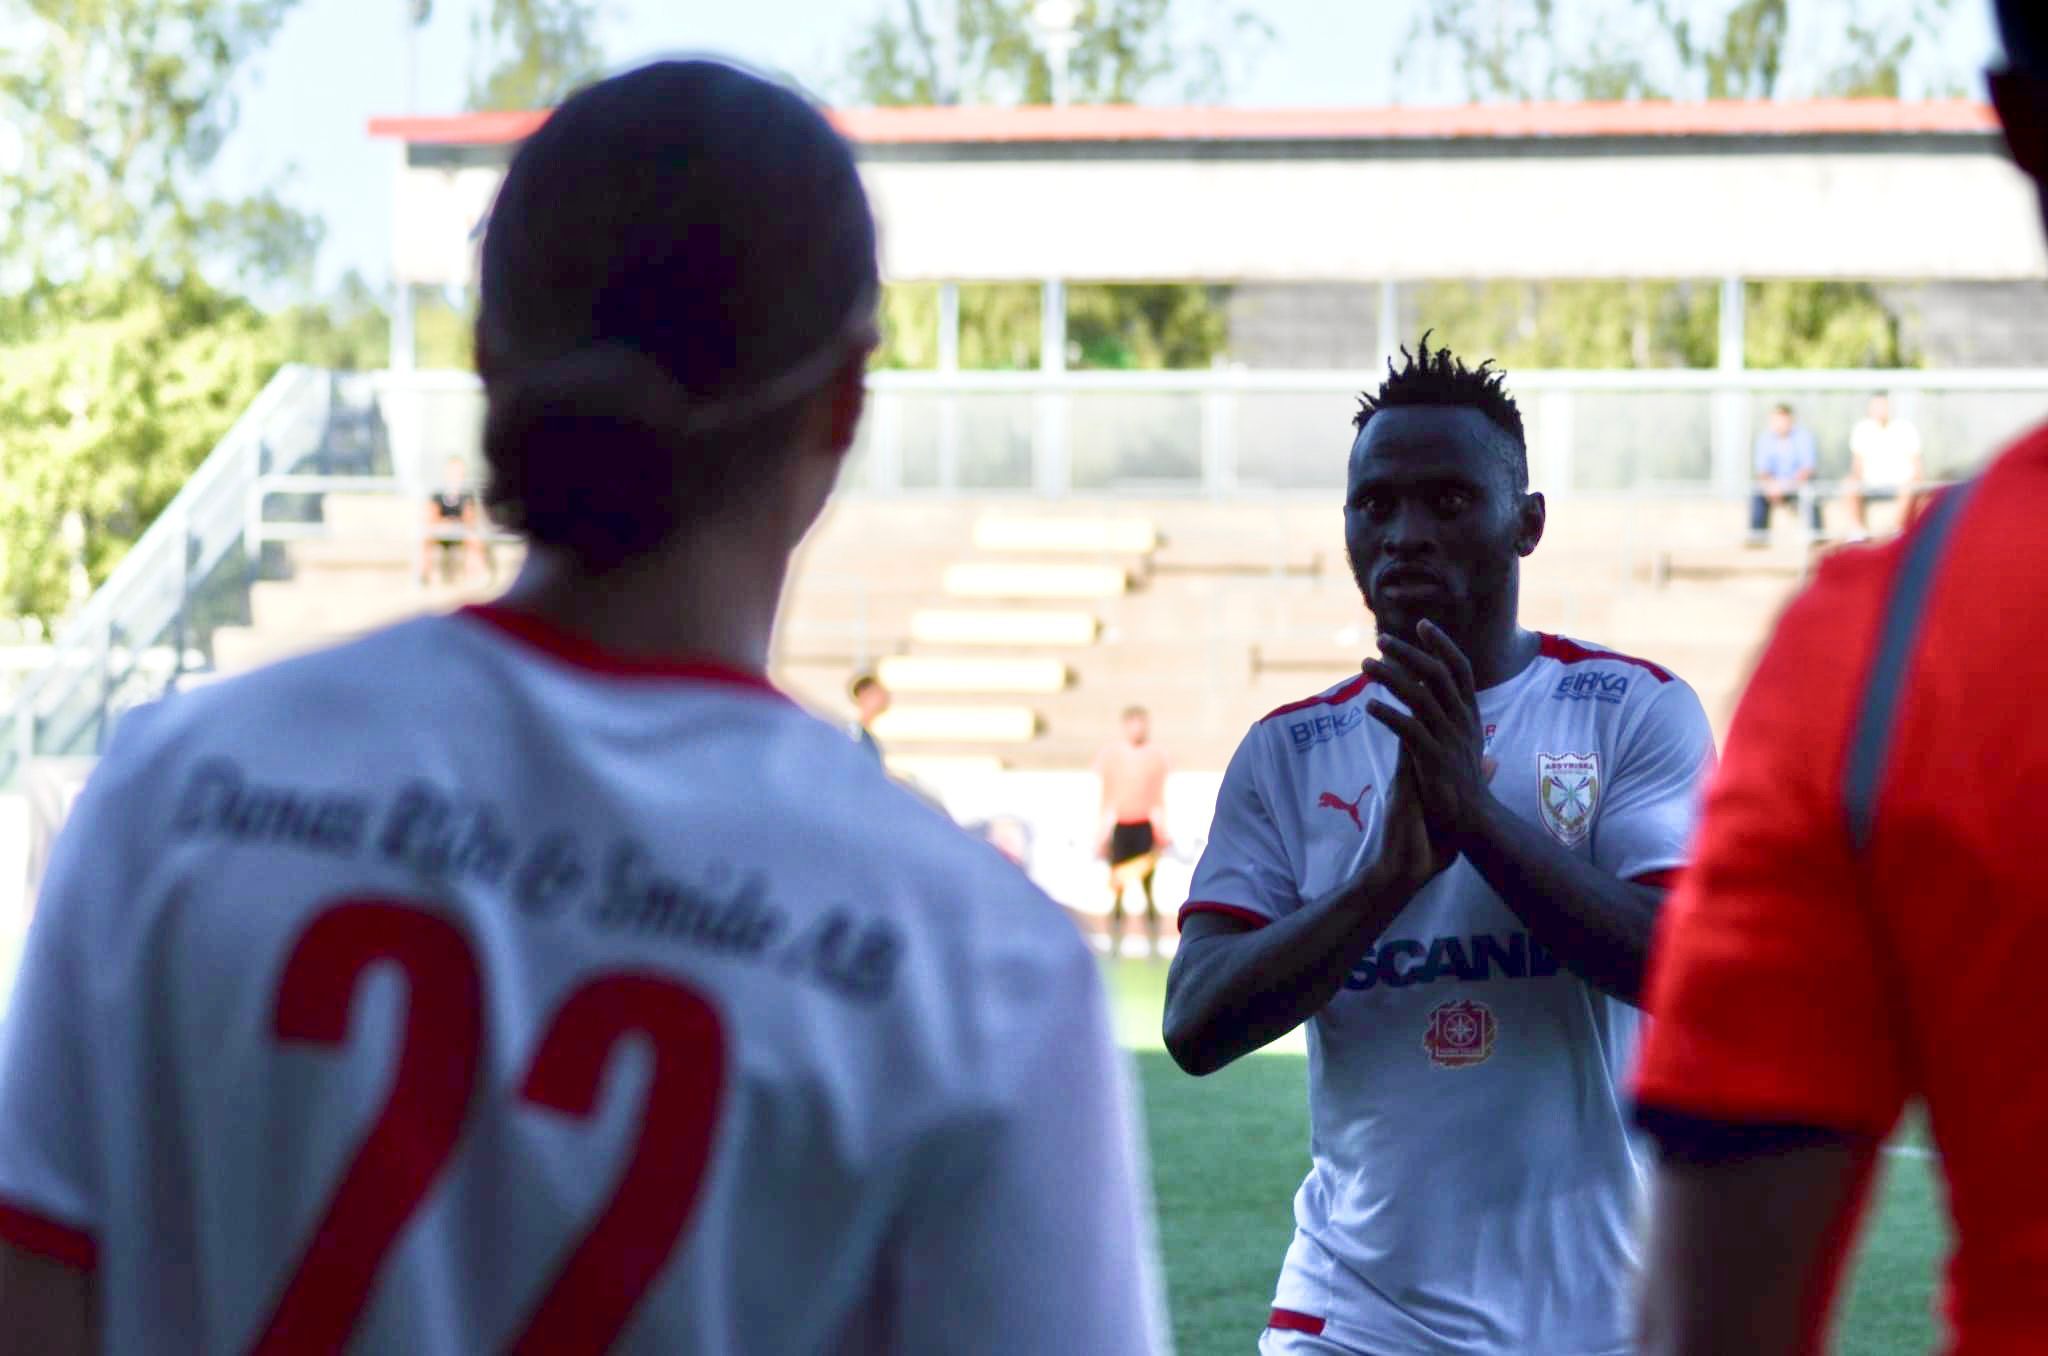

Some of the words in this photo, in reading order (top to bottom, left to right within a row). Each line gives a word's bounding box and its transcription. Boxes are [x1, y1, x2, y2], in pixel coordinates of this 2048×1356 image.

[1556, 671, 1628, 695] BIRKA
[1289, 704, 1362, 745] BIRKA
[1345, 933, 1559, 989] SCANI
[245, 892, 728, 1356] 22
